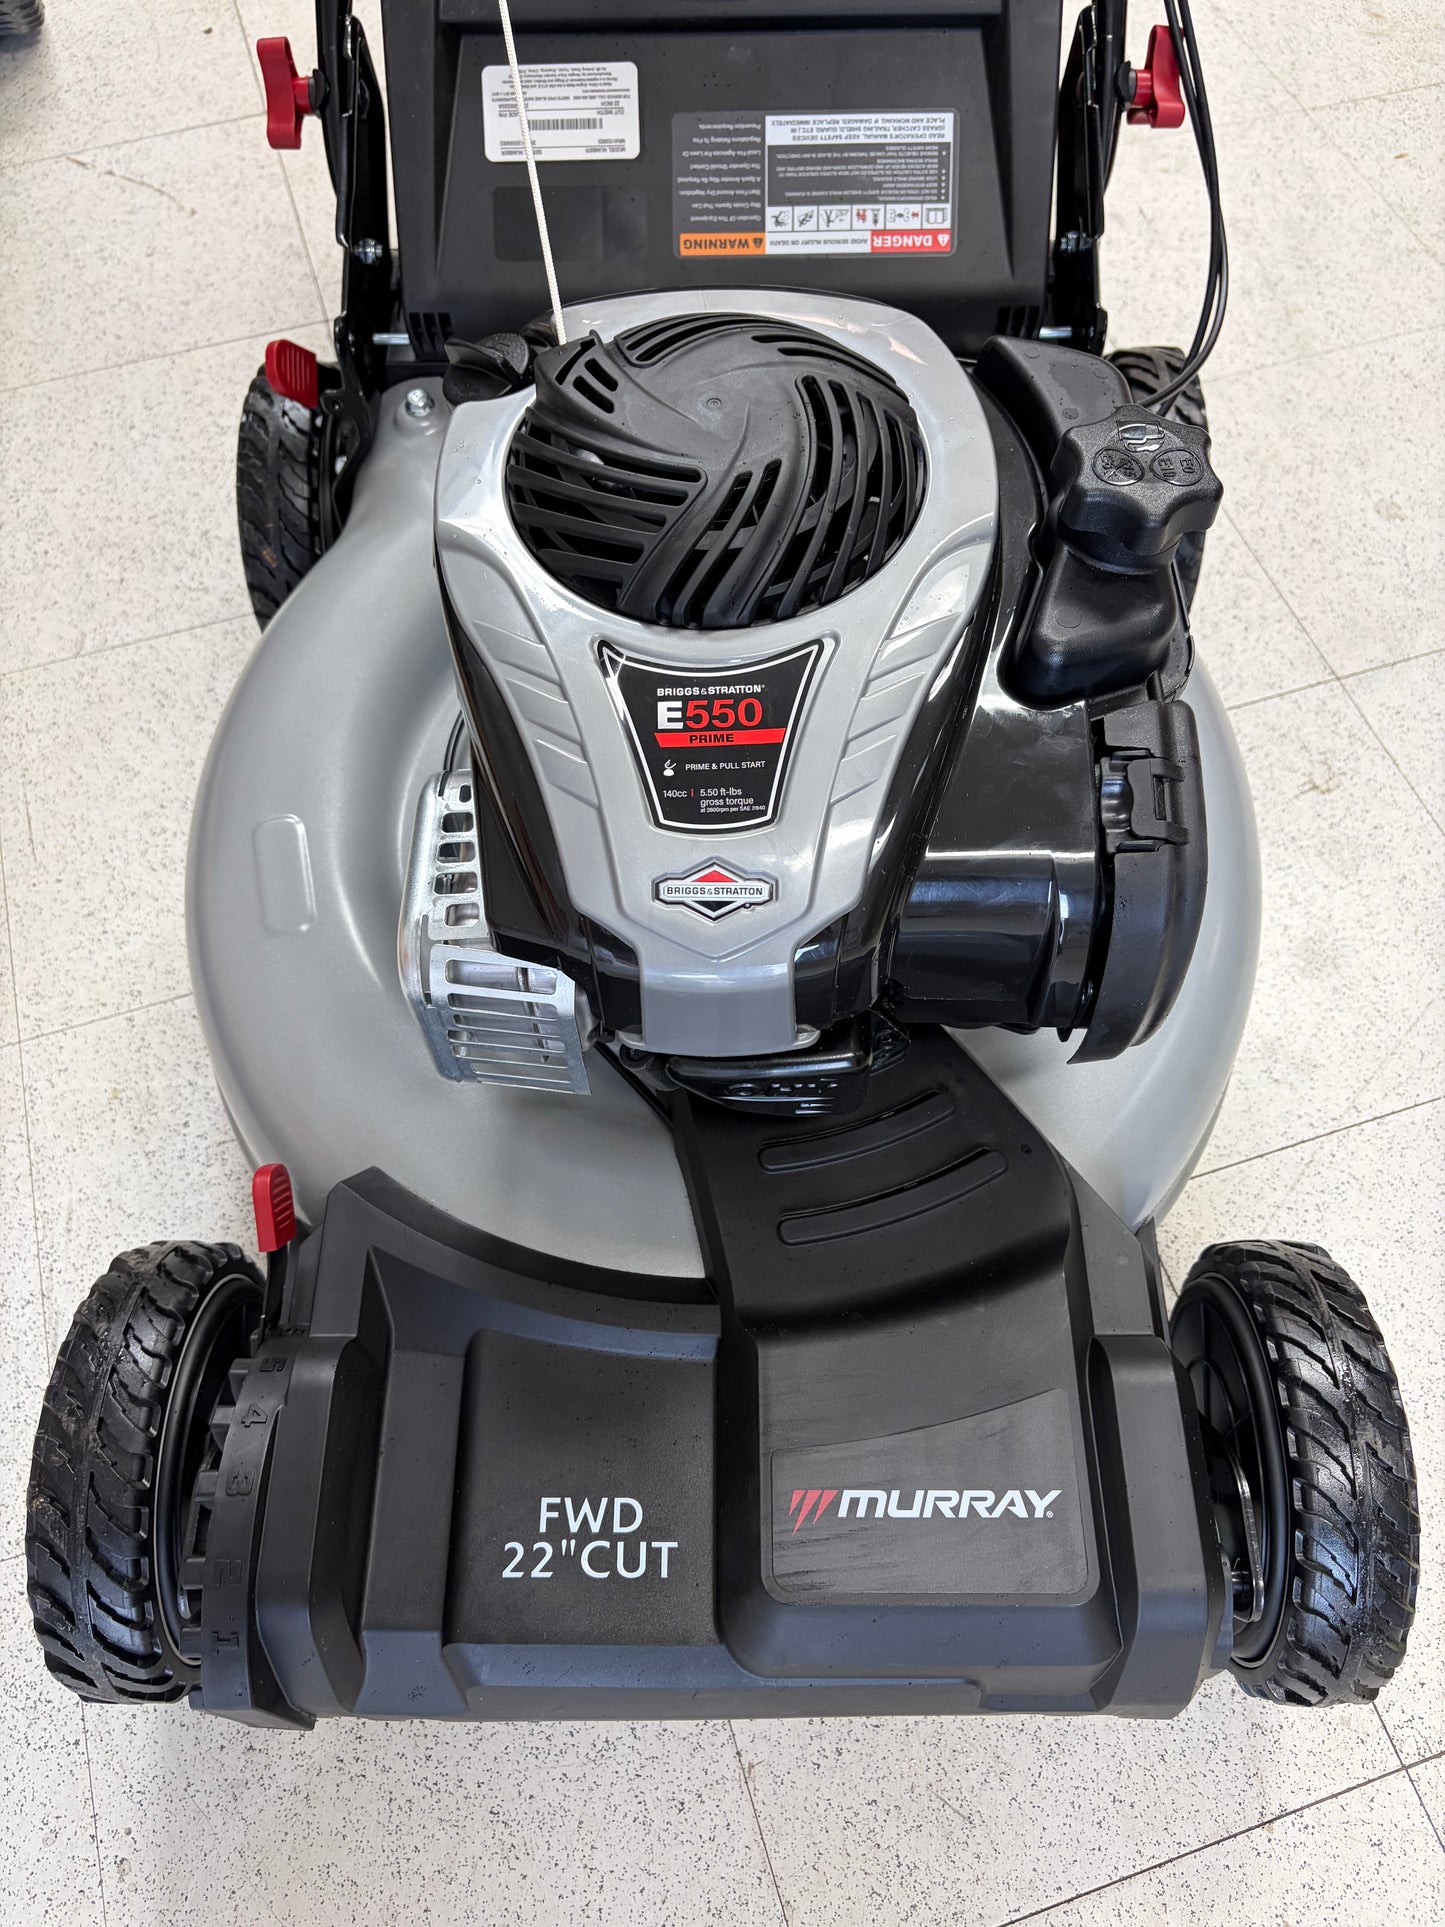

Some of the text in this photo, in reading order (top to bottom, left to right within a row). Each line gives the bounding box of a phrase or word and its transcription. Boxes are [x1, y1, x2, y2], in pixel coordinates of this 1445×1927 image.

[683, 239, 749, 249] WARNING
[873, 235, 932, 247] DANGER
[657, 698, 763, 730] E550
[689, 734, 734, 744] PRIME
[741, 760, 766, 769] START
[663, 790, 688, 798] 140cc
[700, 787, 742, 796] 5.50 ft-lbs
[700, 797, 754, 808] gross torque
[666, 886, 762, 896] BRIGGS&STRATTON
[260, 1358, 288, 1372] 5
[241, 1403, 268, 1428] 4
[225, 1468, 256, 1496] 3
[540, 1497, 644, 1533] FWD
[502, 1538, 678, 1578] 22"CUT
[214, 1560, 242, 1587] 2
